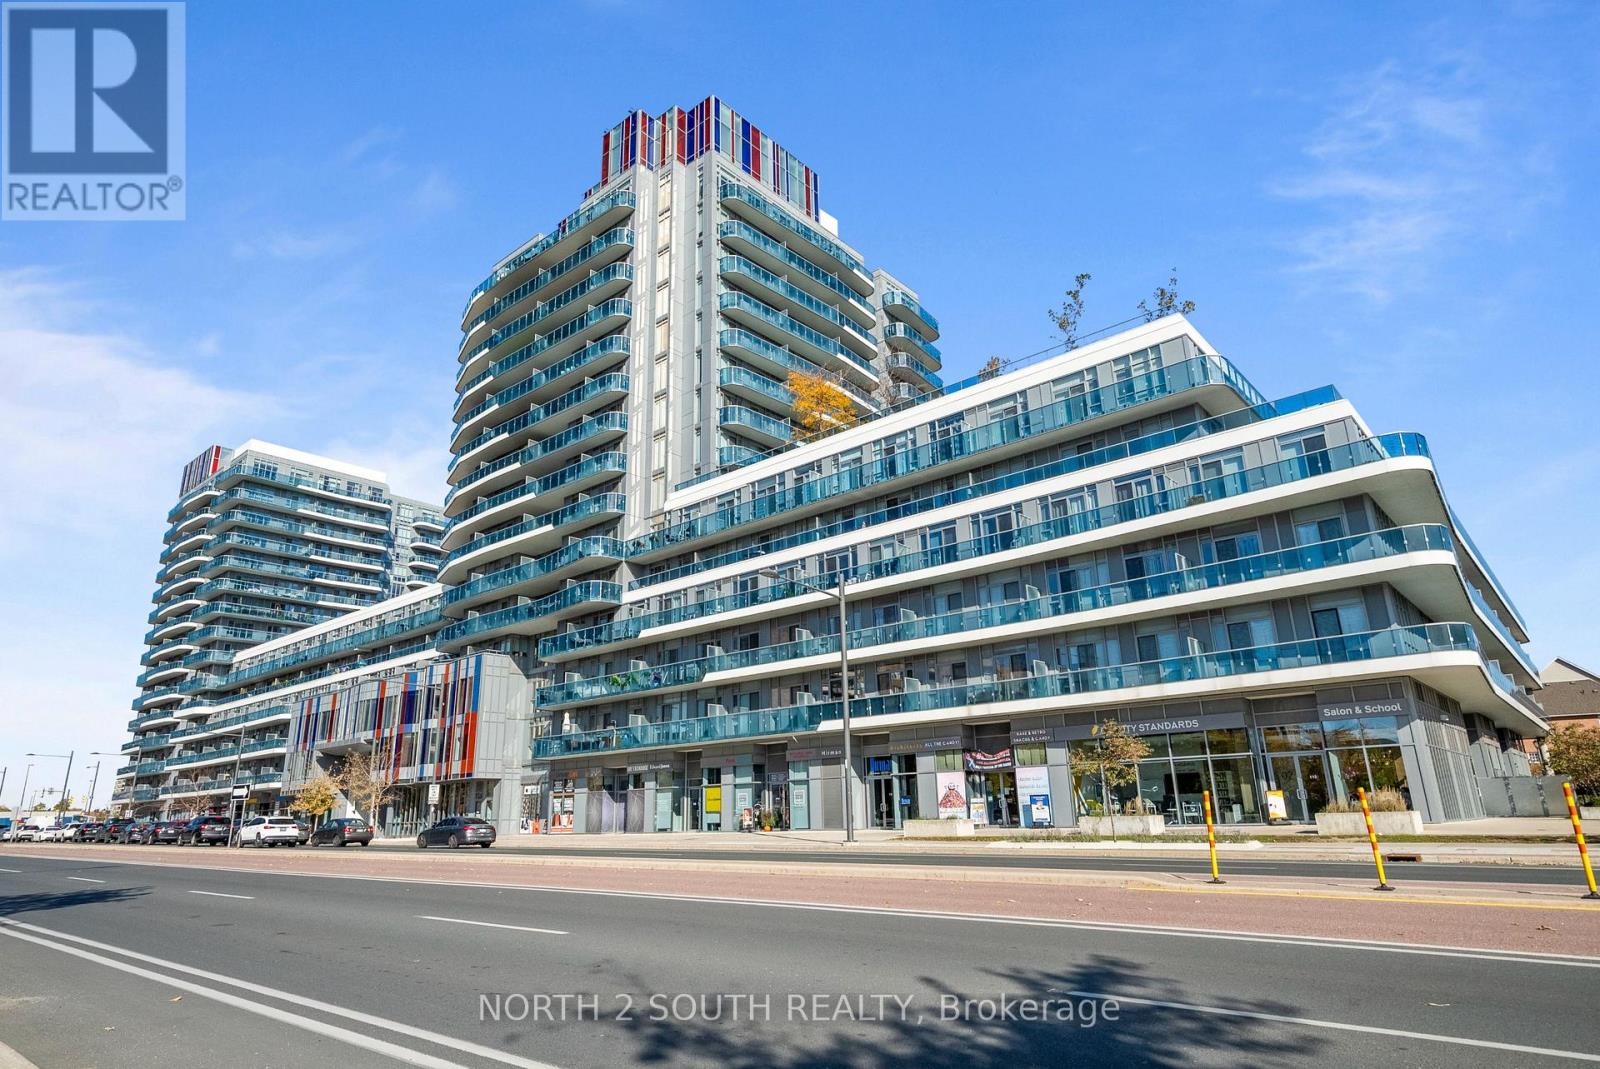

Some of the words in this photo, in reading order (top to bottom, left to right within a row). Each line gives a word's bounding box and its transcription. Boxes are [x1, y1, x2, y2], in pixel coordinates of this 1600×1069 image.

[1323, 708, 1353, 717] Salon
[1354, 705, 1363, 714] &
[1365, 703, 1402, 714] School
[1138, 719, 1199, 732] STANDARDS
